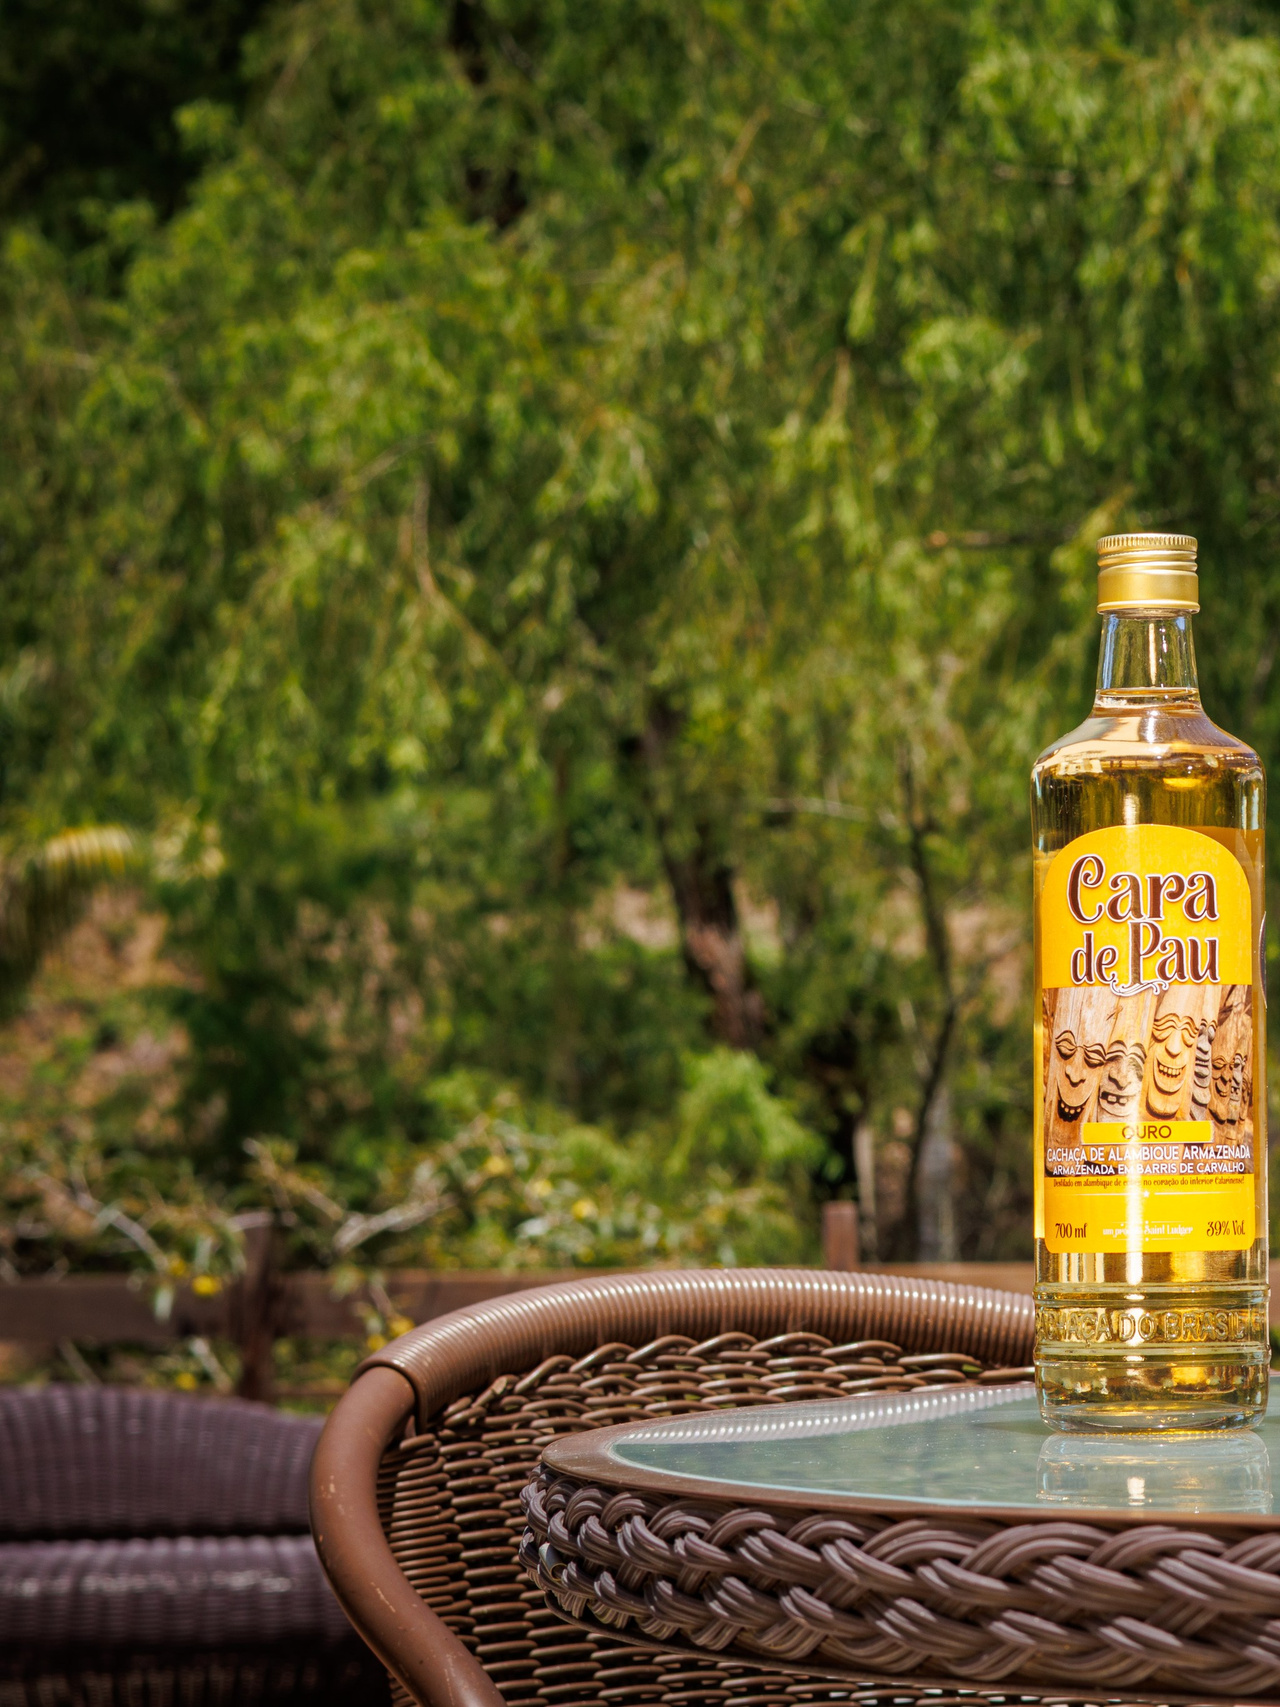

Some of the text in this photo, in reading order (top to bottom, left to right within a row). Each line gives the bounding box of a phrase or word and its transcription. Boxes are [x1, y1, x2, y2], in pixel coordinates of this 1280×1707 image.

[1067, 854, 1219, 924] Cara
[1071, 920, 1220, 996] de Pau
[1121, 1124, 1172, 1140] OURO
[1046, 1144, 1251, 1165] CACHAÇA DE ALAMBIQUE ARMAZENADA
[1052, 1161, 1245, 1175] ARMAZENADA EM BARRIS DE CARVALHO
[1083, 1178, 1113, 1190] alambique
[1114, 1178, 1122, 1186] de
[1180, 1176, 1188, 1185] do
[1054, 1222, 1087, 1239] 700 ml
[1206, 1221, 1230, 1237] 39%
[1118, 1311, 1158, 1341] DO
[1163, 1310, 1245, 1341] BRASIL
